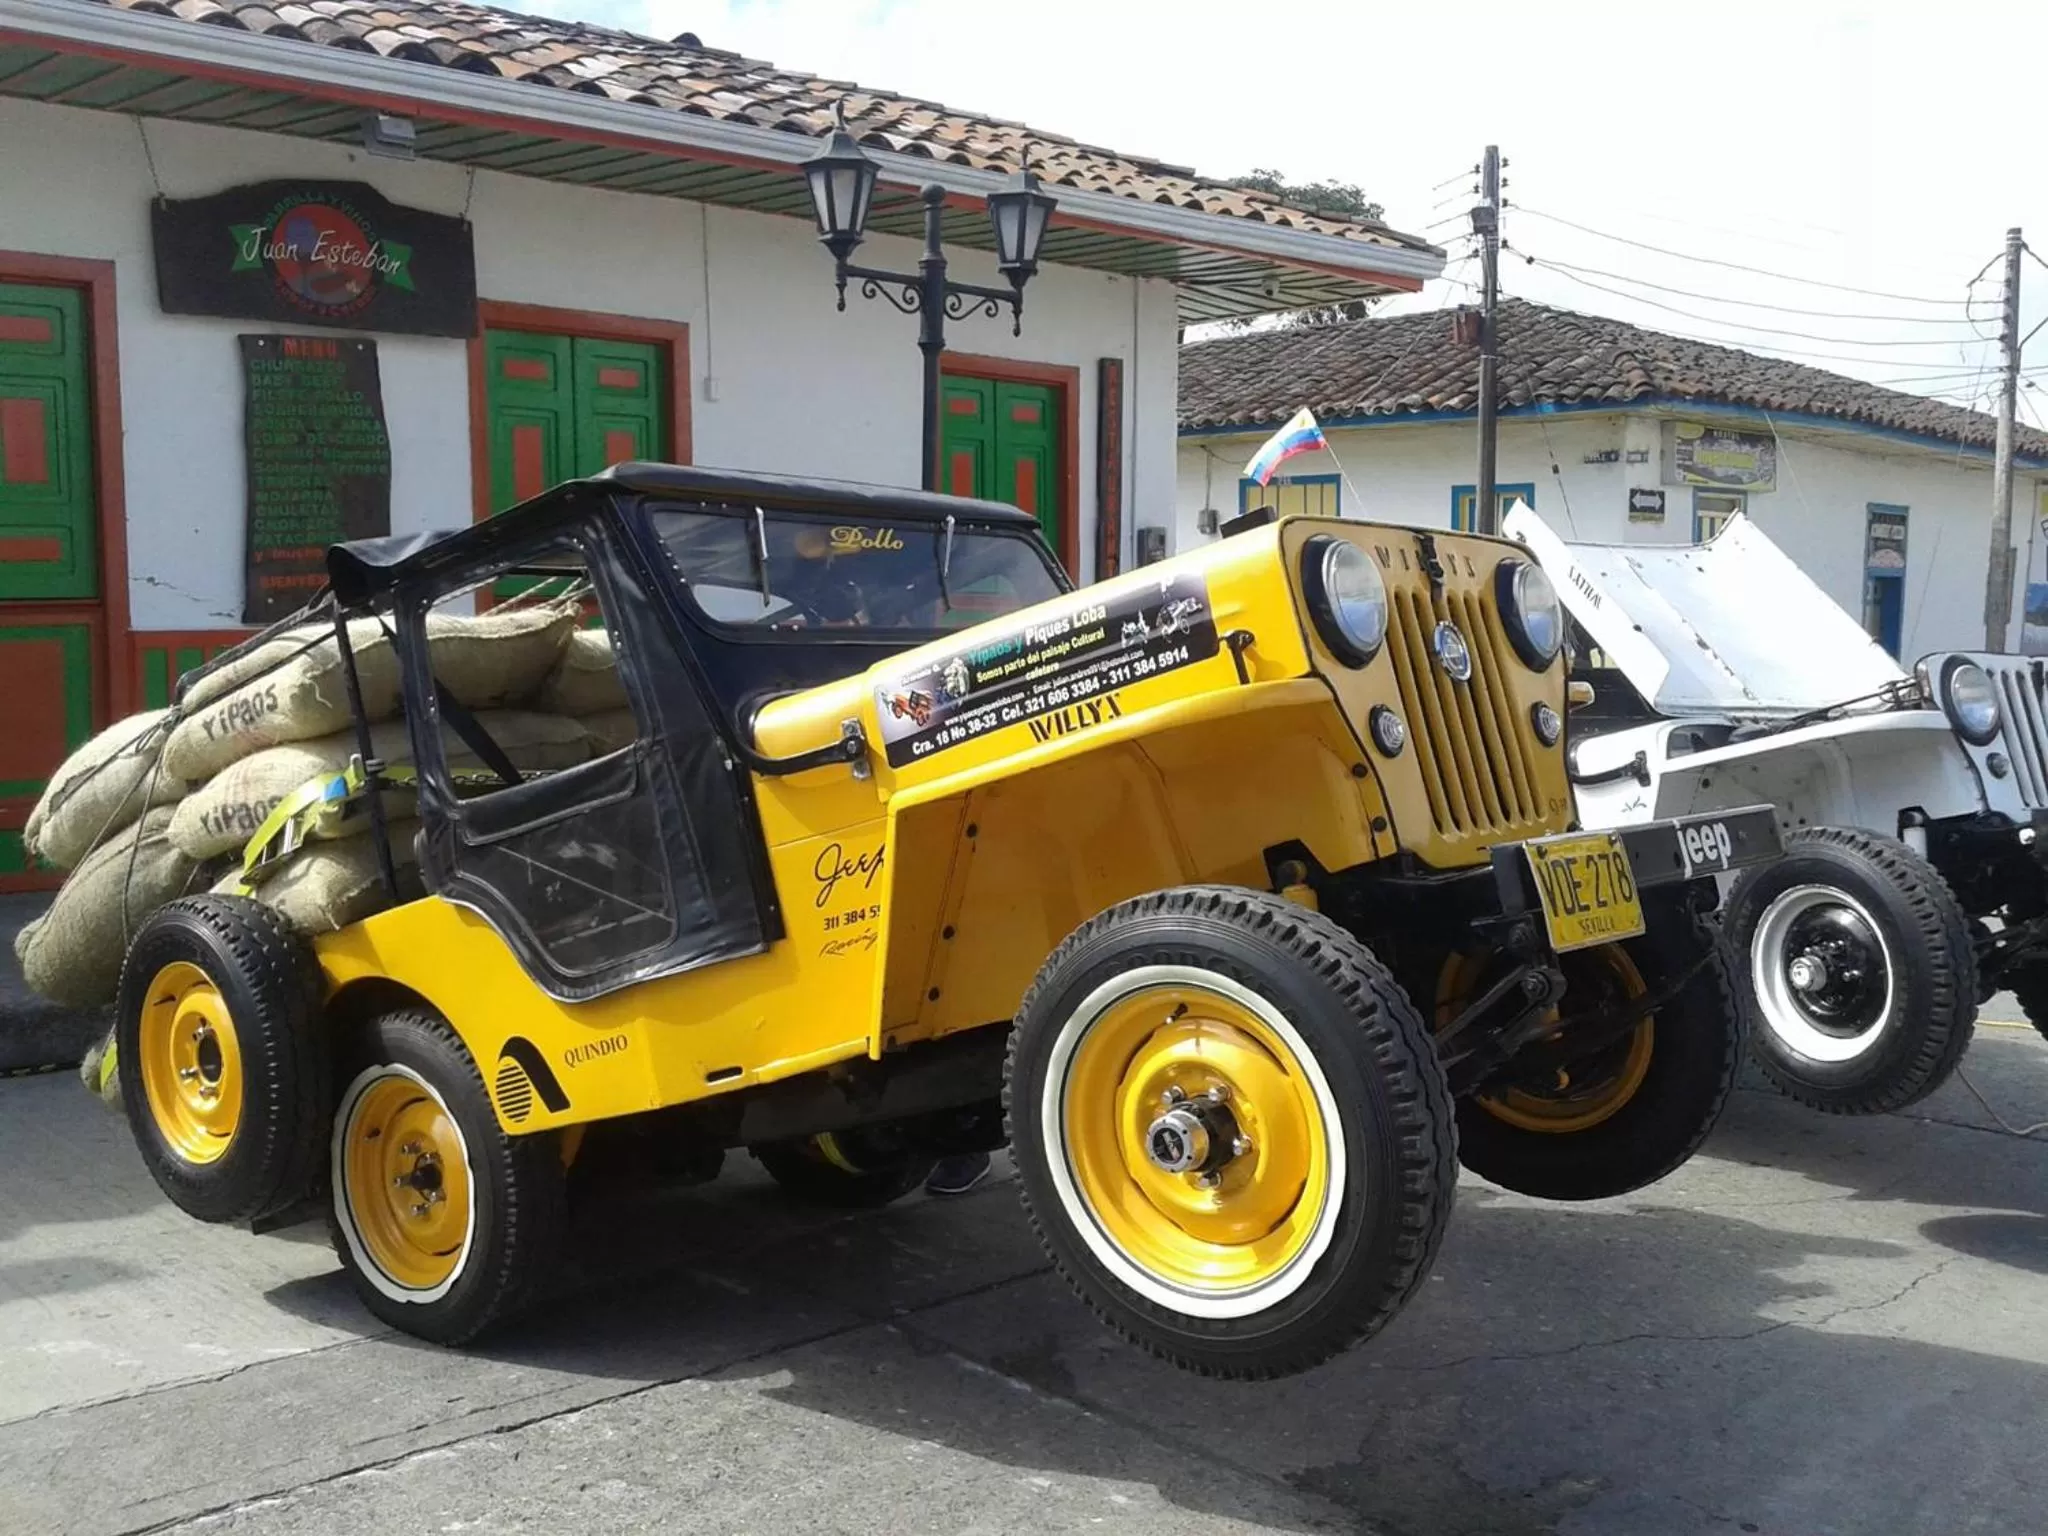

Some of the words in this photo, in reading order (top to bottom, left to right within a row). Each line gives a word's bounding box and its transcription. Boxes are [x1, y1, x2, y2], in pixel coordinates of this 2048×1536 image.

[242, 227, 298, 261] Juan
[310, 230, 401, 275] Esteban
[830, 526, 904, 549] Pollo
[1375, 545, 1475, 578] WILYS
[1024, 618, 1070, 646] Piques
[1072, 604, 1107, 629] Loba
[976, 666, 1003, 683] Somos
[1004, 658, 1026, 676] parte
[1026, 651, 1040, 665] del
[1041, 641, 1071, 662] paisaje
[1071, 627, 1106, 648] Cultural
[1025, 661, 1060, 680] cafetero
[912, 740, 935, 756] Cra.
[936, 731, 949, 746] 18
[950, 726, 966, 741] No
[967, 713, 998, 735] 38-32
[1002, 703, 1024, 721] Cel.
[1024, 697, 1045, 713] 321
[1071, 676, 1100, 697] 3384
[1109, 665, 1131, 684] 311
[1134, 657, 1157, 676] 384
[1158, 645, 1189, 668] 5914
[815, 843, 885, 908] Jeep
[1586, 851, 1633, 908] 278
[823, 915, 840, 932] 311
[843, 908, 866, 927] 384
[564, 1034, 628, 1068] QUINDIO
